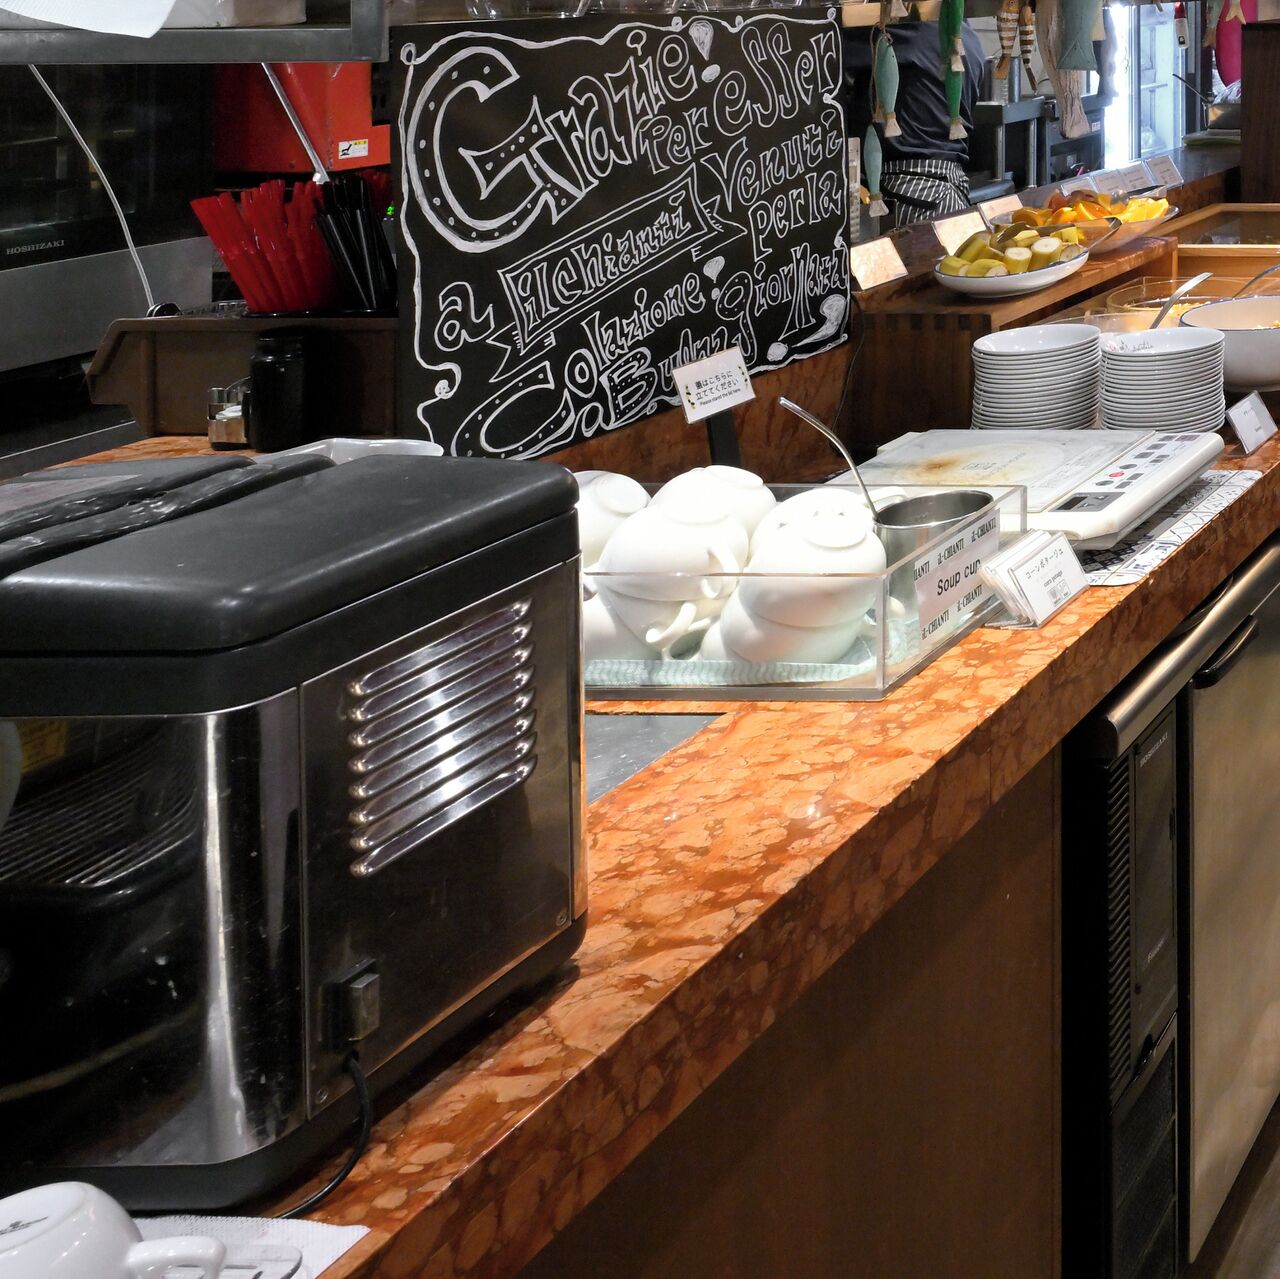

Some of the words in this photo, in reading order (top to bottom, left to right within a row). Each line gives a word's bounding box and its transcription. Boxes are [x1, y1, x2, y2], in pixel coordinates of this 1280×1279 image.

[6, 239, 65, 255] HOSHIZAKI
[1026, 547, 1064, 580] コーンポタージュ
[937, 571, 961, 596] Soup
